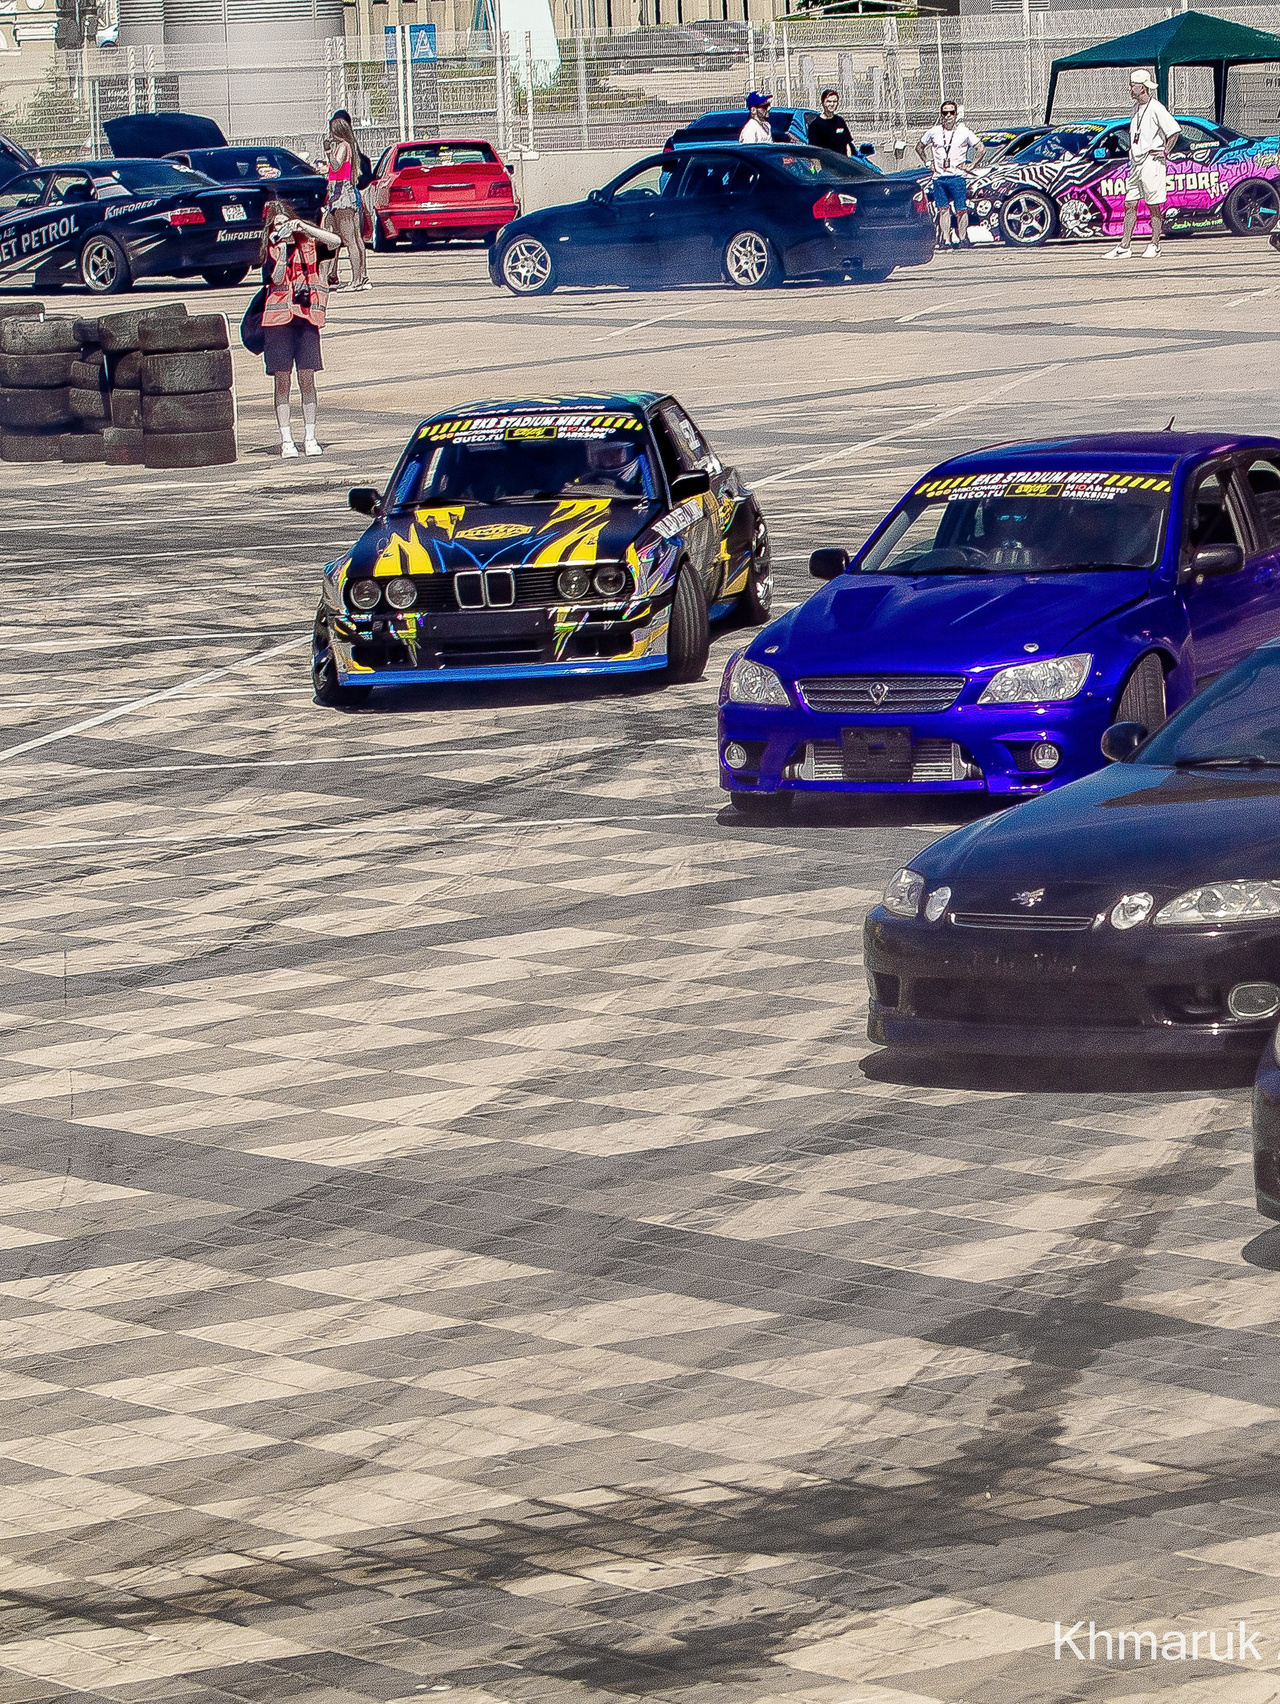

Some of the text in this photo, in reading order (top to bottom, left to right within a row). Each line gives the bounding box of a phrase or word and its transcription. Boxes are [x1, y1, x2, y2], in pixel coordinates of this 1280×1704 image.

[1165, 171, 1220, 192] STORE
[0, 214, 80, 263] ET PETROL
[497, 416, 557, 429] STADIUM
[555, 416, 594, 427] MEET
[452, 433, 505, 444] auto.ru
[1001, 472, 1069, 484] STADIUM
[1063, 472, 1110, 485] MEET
[948, 489, 1005, 501] auto.ru
